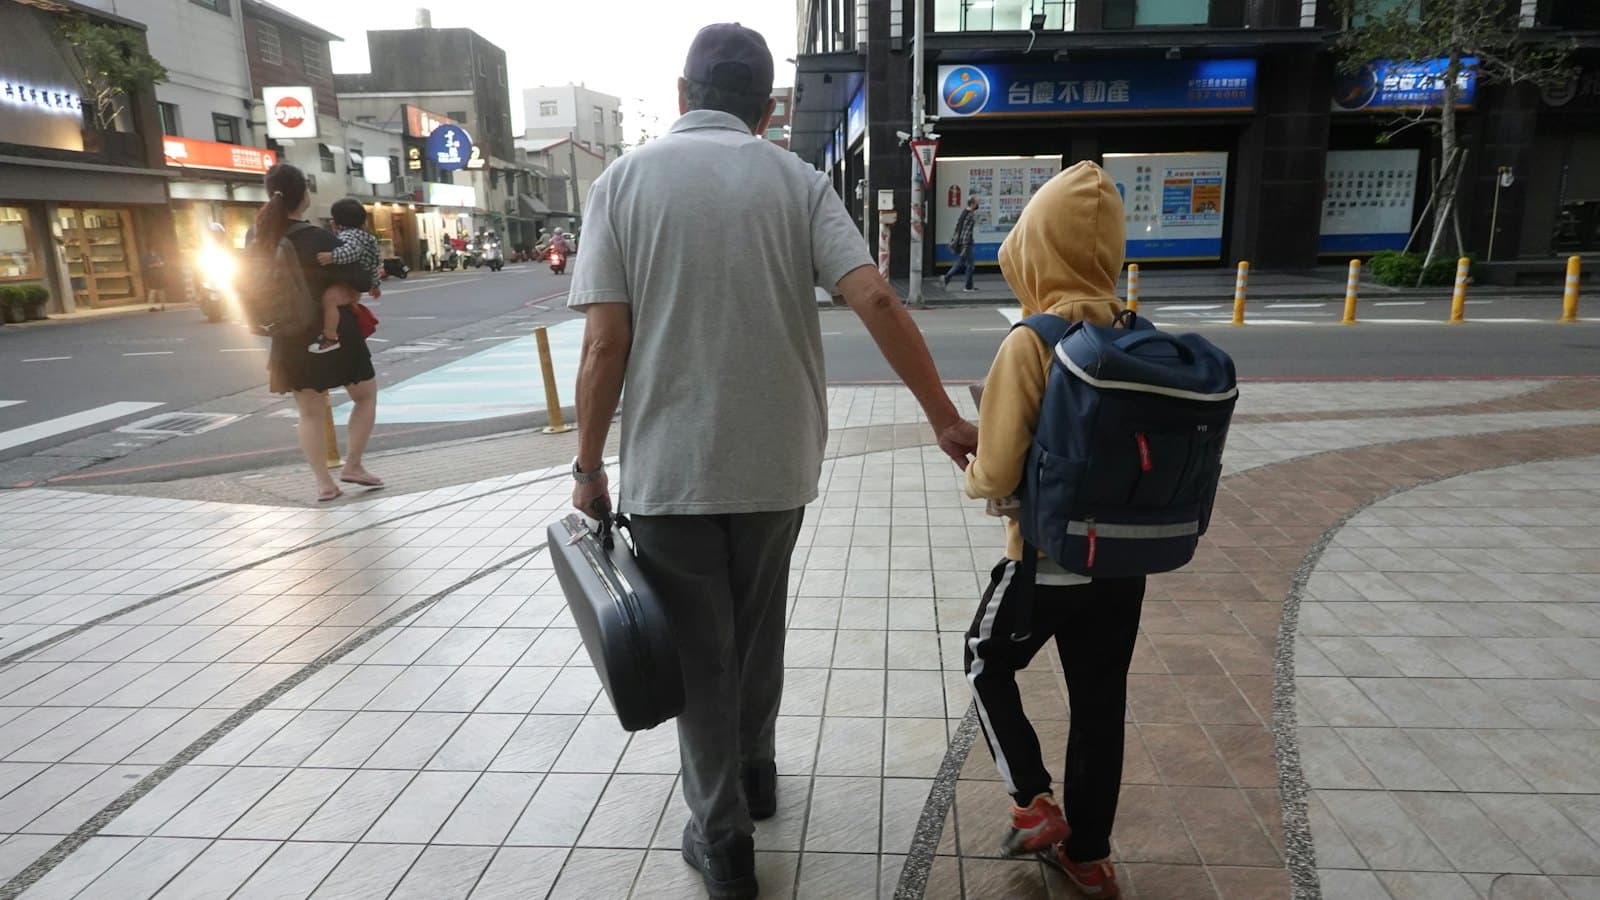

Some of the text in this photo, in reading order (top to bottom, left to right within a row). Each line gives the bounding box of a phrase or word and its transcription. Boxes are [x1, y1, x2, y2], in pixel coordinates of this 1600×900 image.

[1008, 80, 1130, 105] 台慶不動產
